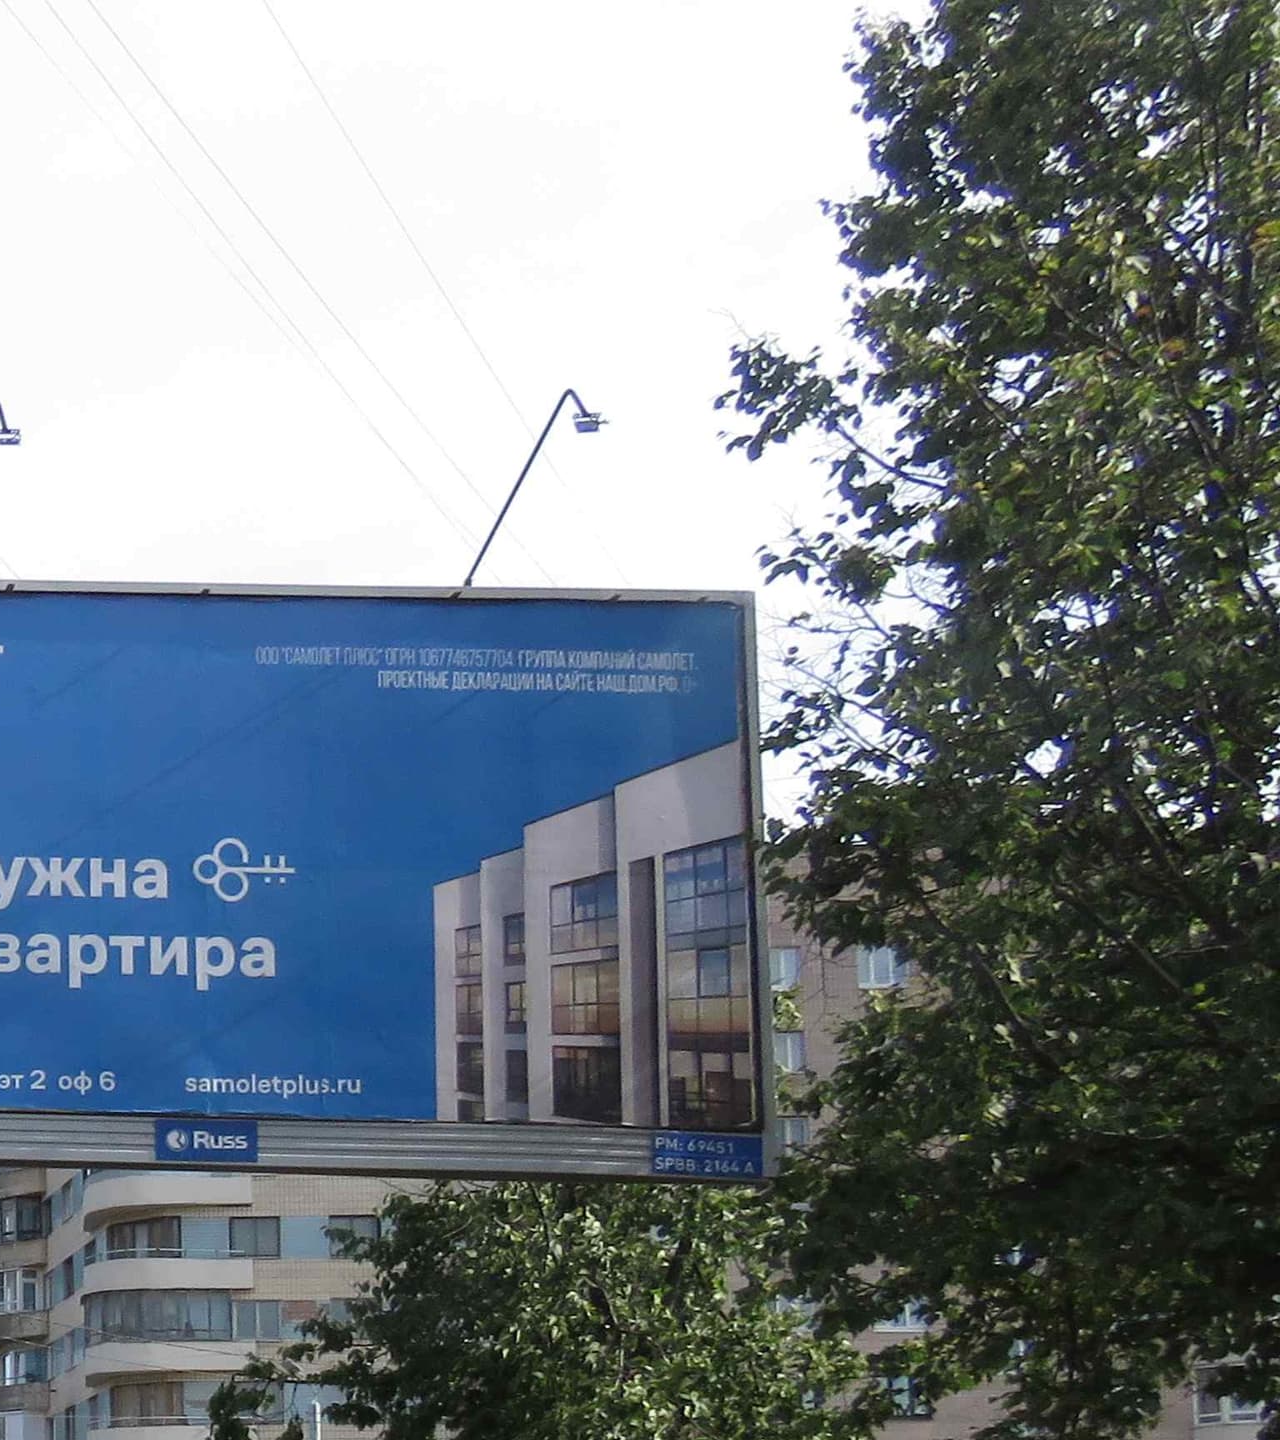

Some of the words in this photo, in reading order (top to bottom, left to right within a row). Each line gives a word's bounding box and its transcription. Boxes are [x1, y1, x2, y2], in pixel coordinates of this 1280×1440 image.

[518, 649, 565, 669] ГРУППА
[568, 649, 636, 670] КОМПАНИЙ
[377, 670, 450, 689] ПРОЕКТНЫЕ
[451, 671, 535, 692] ДЕКЛАРАЦИИ
[536, 672, 554, 691] НА
[555, 670, 595, 692] САЙТЕ
[29, 1070, 47, 1091] 2
[58, 1070, 93, 1096] оф
[98, 1071, 117, 1091] 6
[184, 1074, 361, 1099] samoletplus.ru
[192, 1130, 249, 1150] Russ
[687, 1139, 734, 1155] 69451
